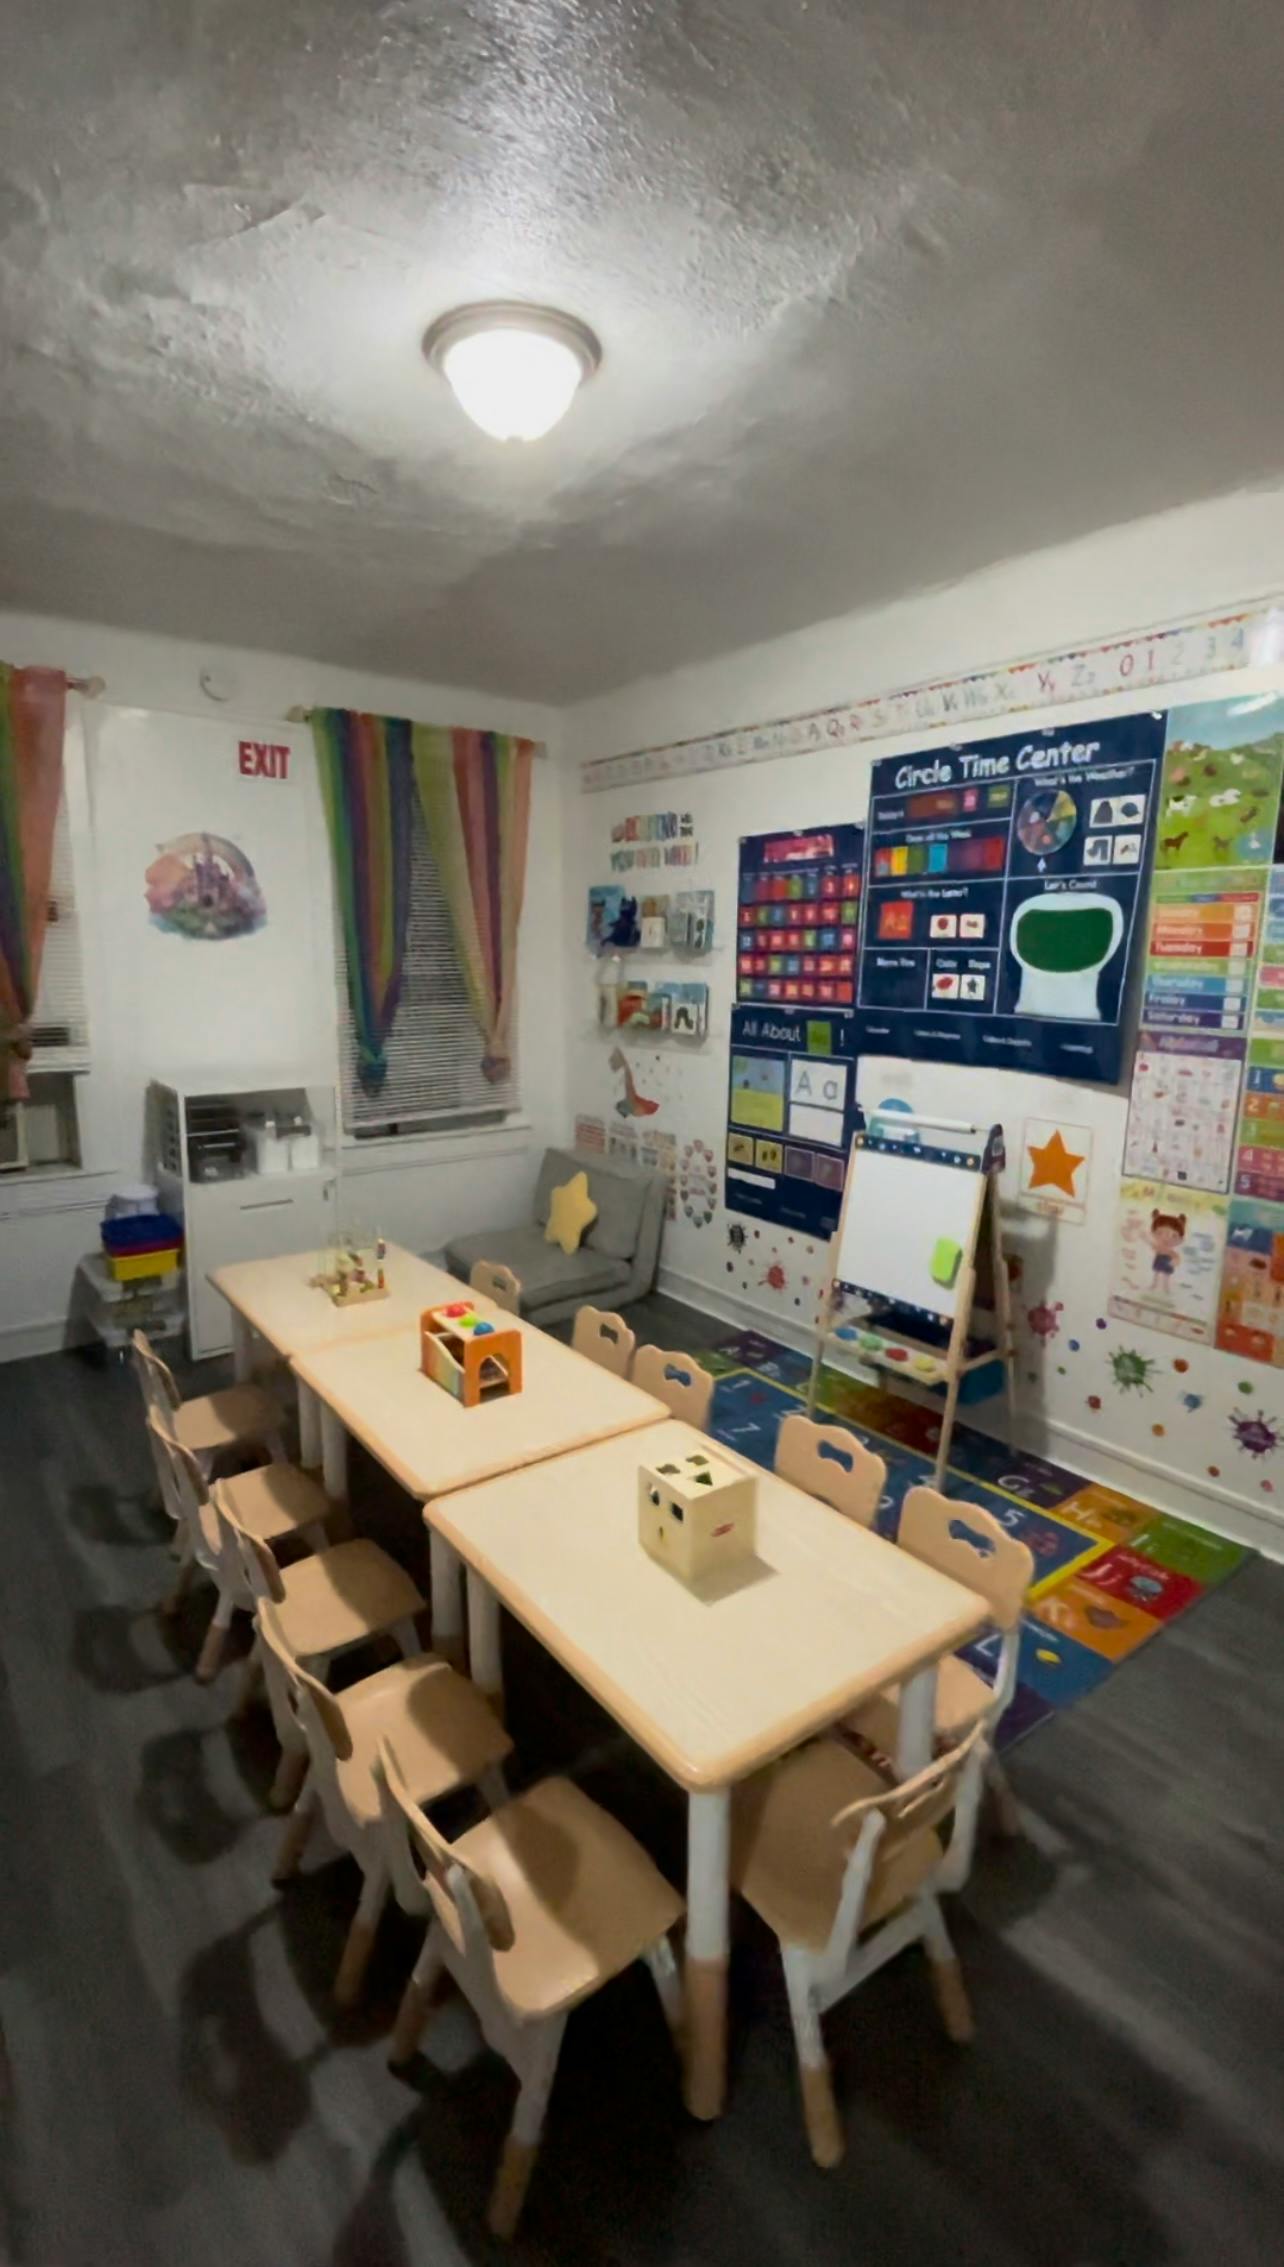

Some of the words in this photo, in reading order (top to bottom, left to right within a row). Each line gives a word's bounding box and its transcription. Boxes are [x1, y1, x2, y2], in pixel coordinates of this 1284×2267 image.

[239, 740, 290, 779] EXIT
[894, 760, 951, 789] Circle
[959, 754, 1010, 779] Time
[1016, 741, 1100, 772] Center
[742, 1019, 757, 1037] All
[762, 1021, 801, 1042] About
[796, 1070, 812, 1097] A
[823, 1079, 838, 1100] a
